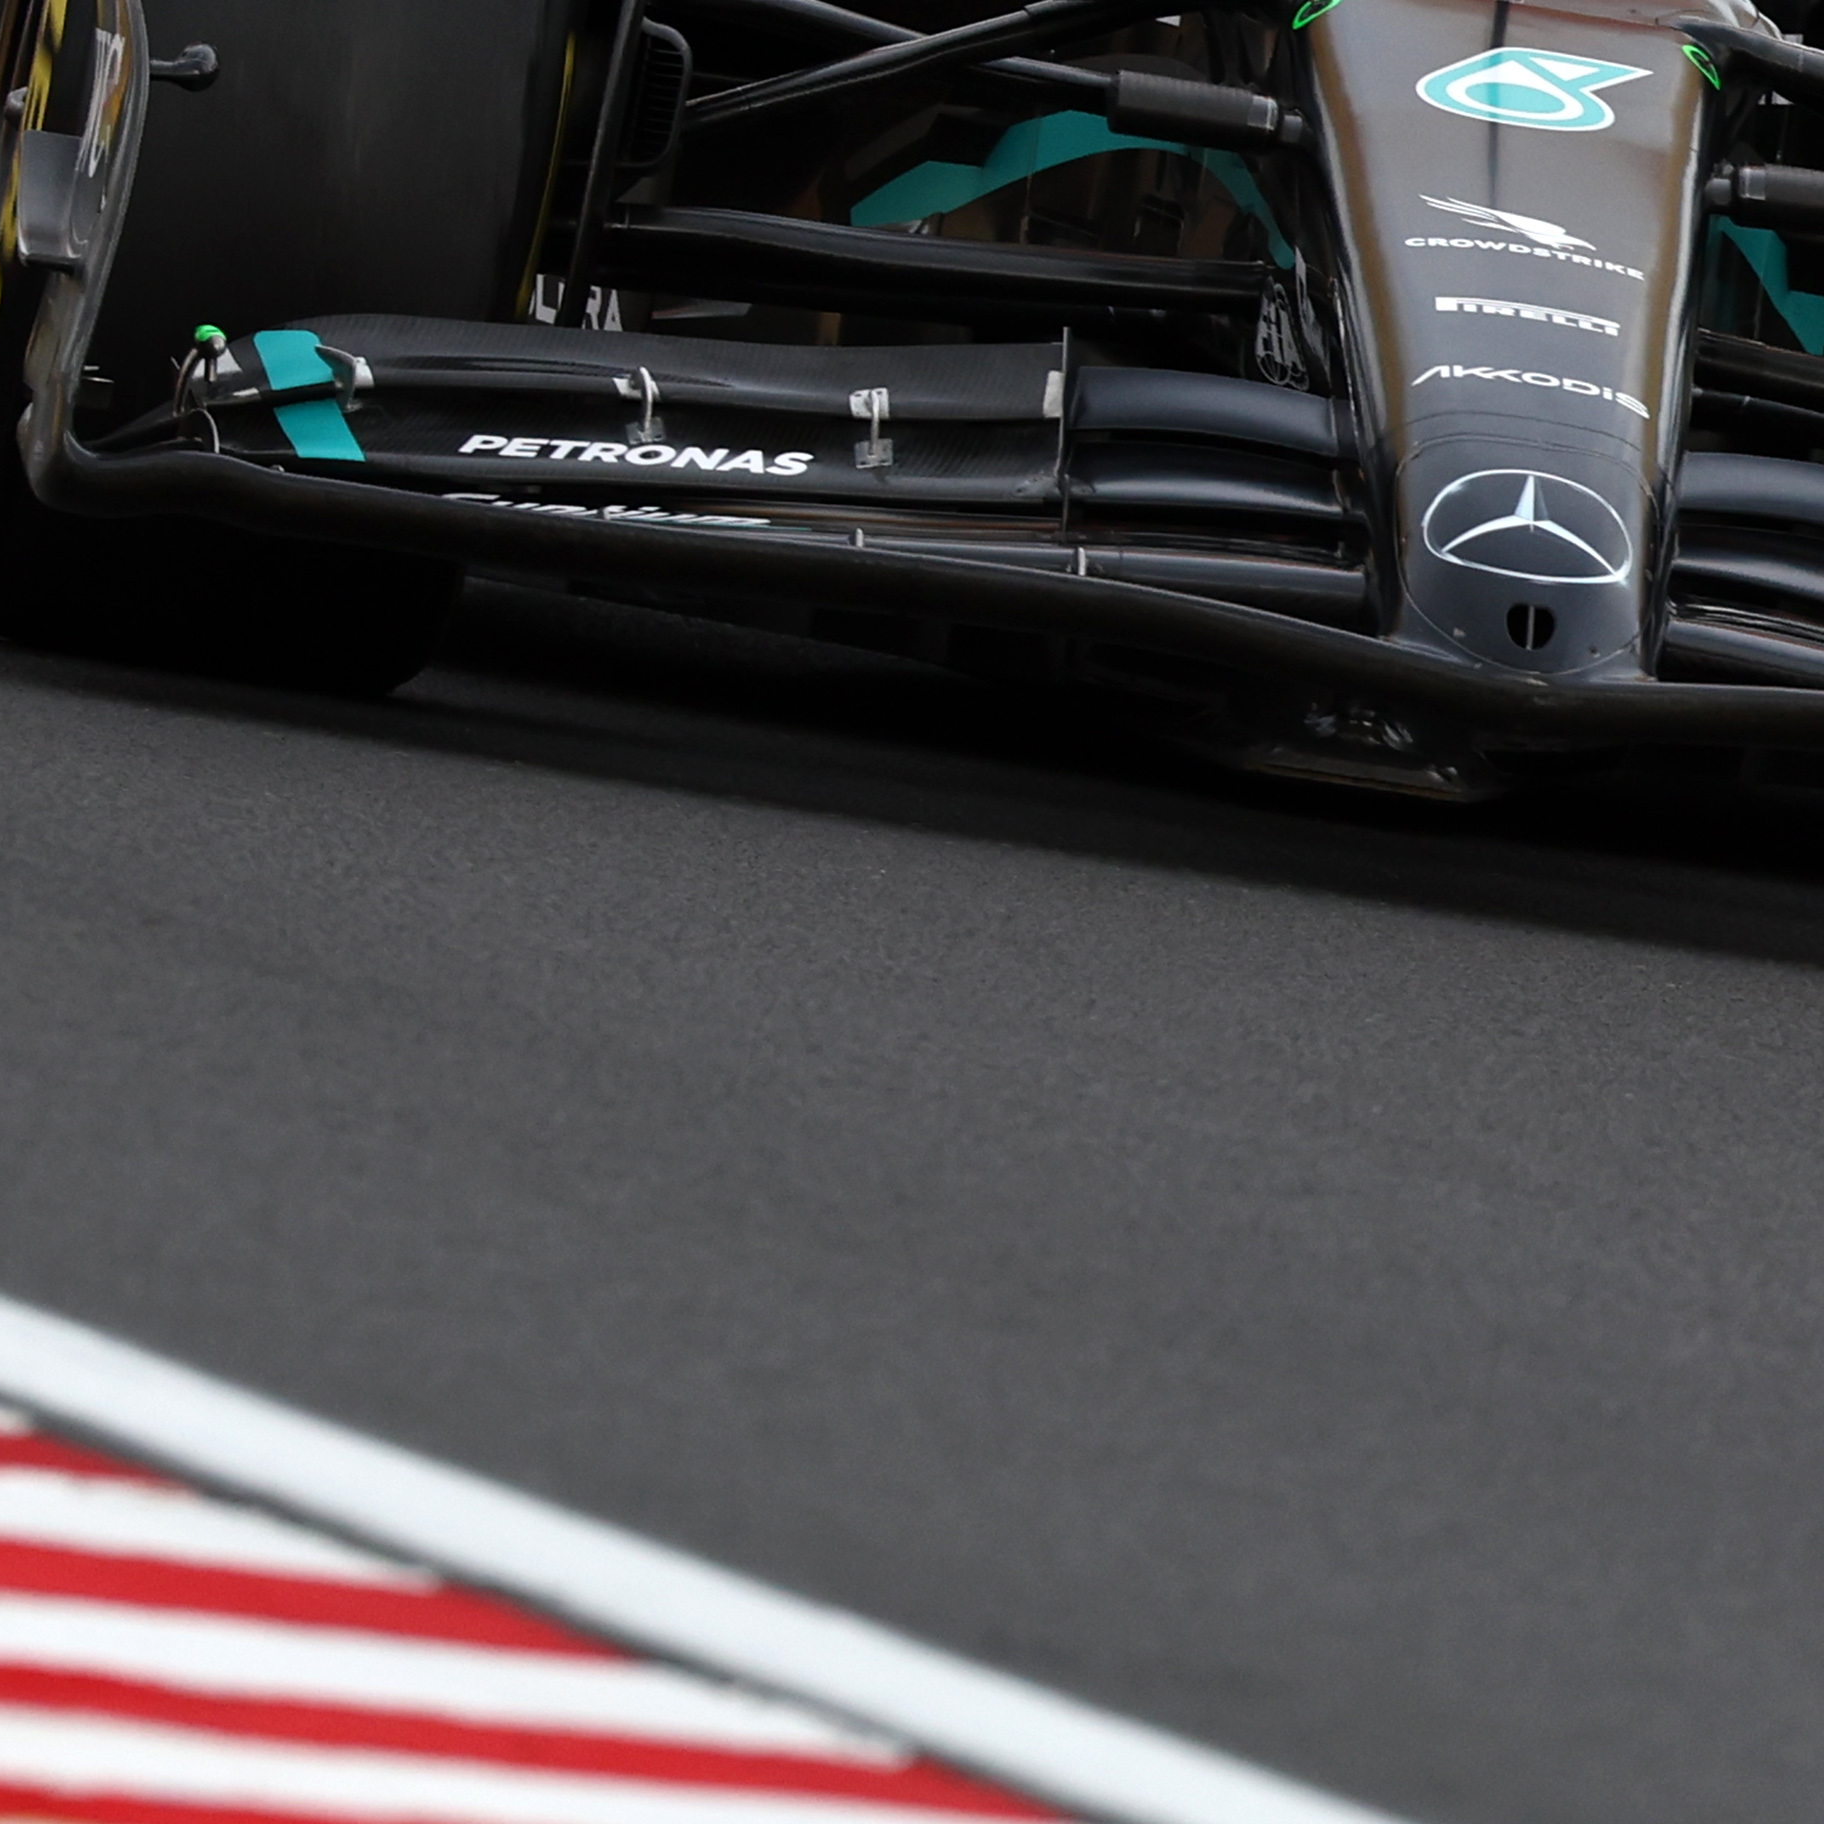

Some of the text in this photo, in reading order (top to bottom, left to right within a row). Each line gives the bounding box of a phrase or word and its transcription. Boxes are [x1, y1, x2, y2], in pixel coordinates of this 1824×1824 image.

[1404, 236, 1646, 281] CROWDSTRIKE
[1434, 295, 1622, 337] PIRELLI
[458, 433, 815, 476] PETRONAS
